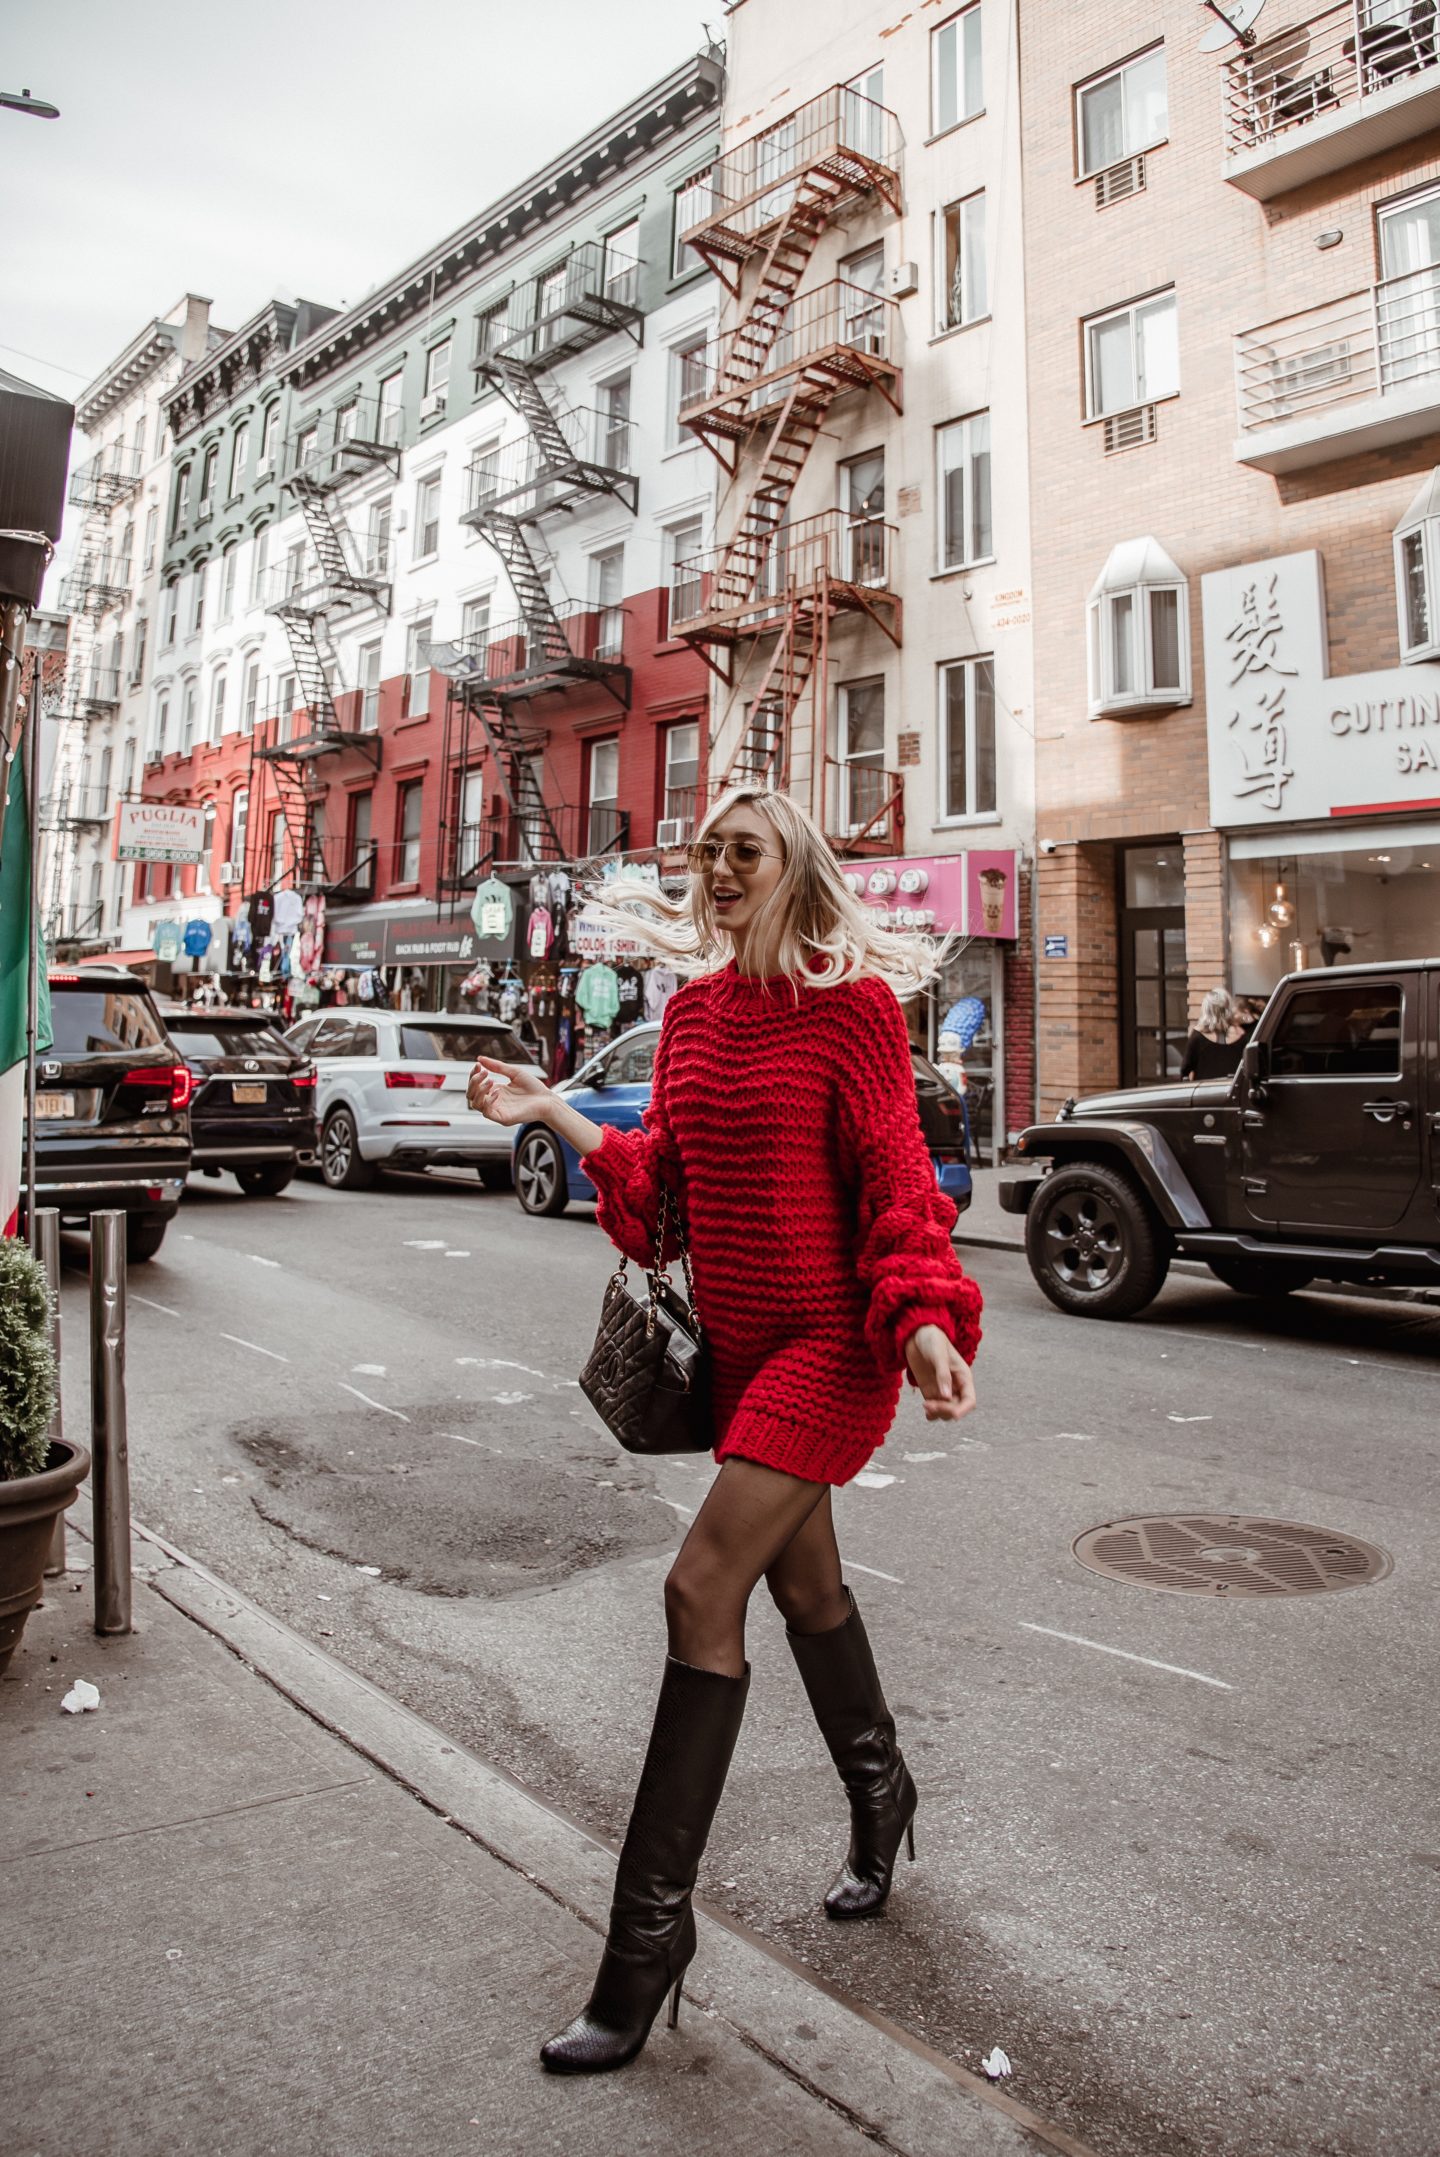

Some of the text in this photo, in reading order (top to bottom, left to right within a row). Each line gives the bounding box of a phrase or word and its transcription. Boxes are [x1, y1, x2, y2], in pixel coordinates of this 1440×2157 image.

[1328, 691, 1440, 737] CUTTIN
[1396, 739, 1438, 774] SA
[129, 808, 198, 829] PUGLIA
[577, 937, 605, 951] COLOR
